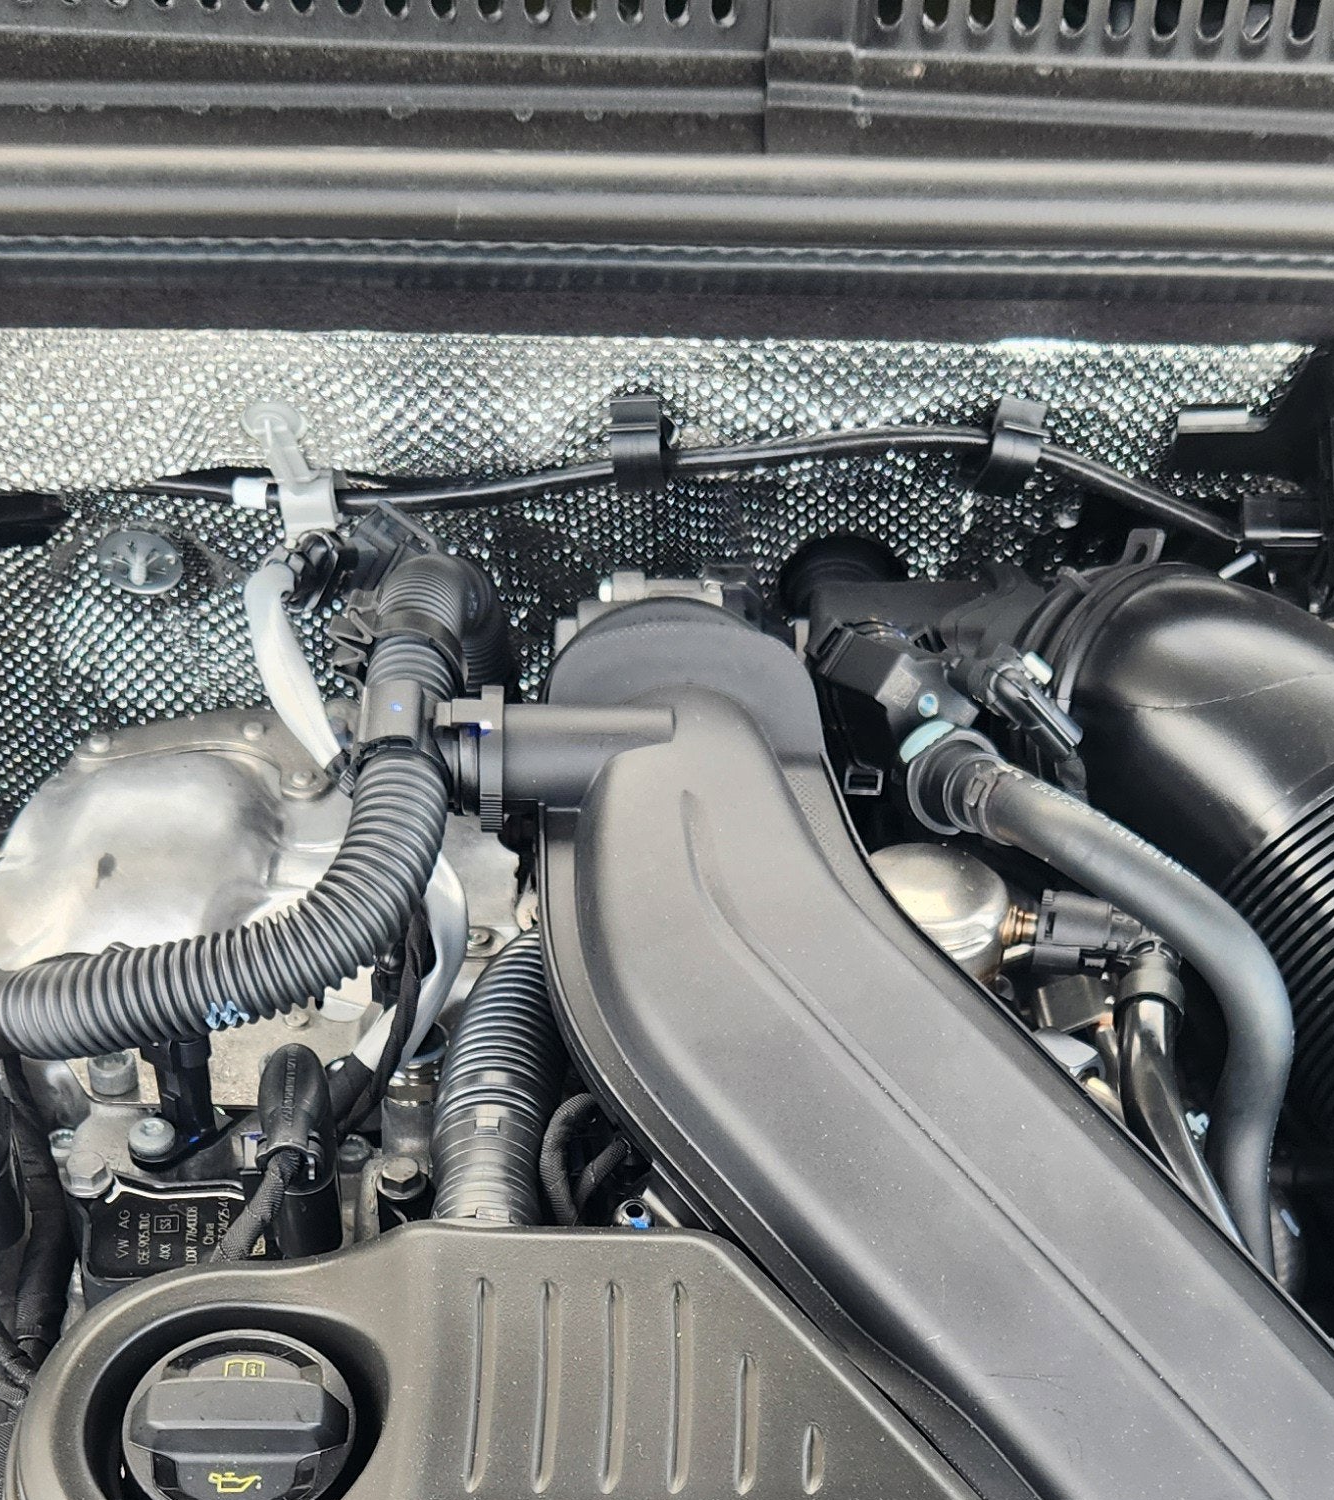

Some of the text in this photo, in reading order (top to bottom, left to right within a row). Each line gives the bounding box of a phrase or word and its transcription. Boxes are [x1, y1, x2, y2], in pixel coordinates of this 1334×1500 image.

[116, 1209, 130, 1260] VW AG
[161, 1218, 173, 1230] S3
[202, 1223, 213, 1246] China
[184, 1245, 199, 1268] LDOR
